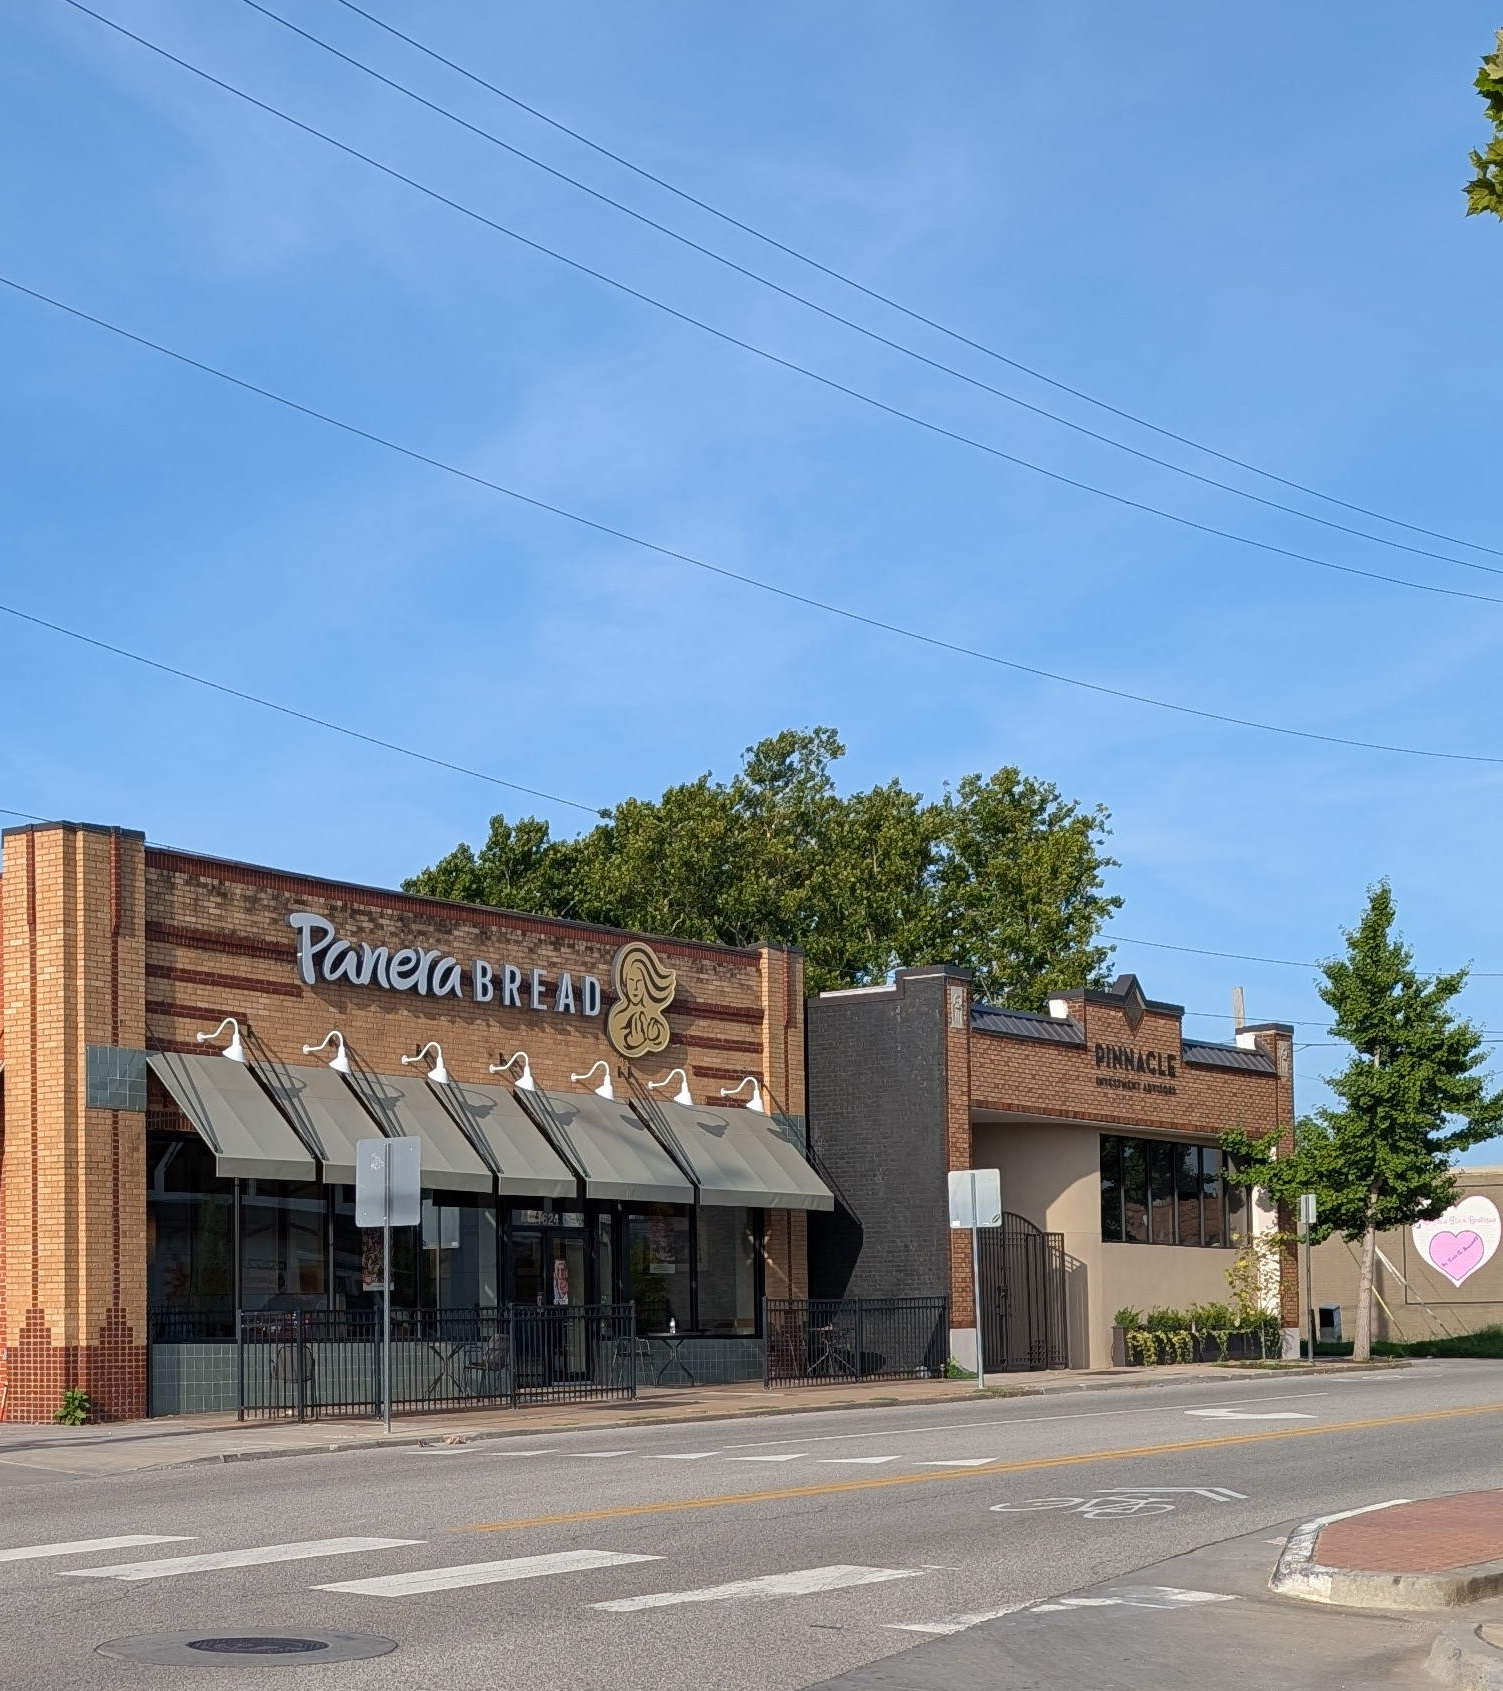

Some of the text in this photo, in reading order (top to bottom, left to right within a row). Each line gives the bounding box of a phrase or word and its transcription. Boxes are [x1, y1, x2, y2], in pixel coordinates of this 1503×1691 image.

[289, 912, 602, 1016] Panera BREAD
[1095, 1043, 1177, 1078] PINNACLE
[1096, 1076, 1140, 1091] INVESTMENT
